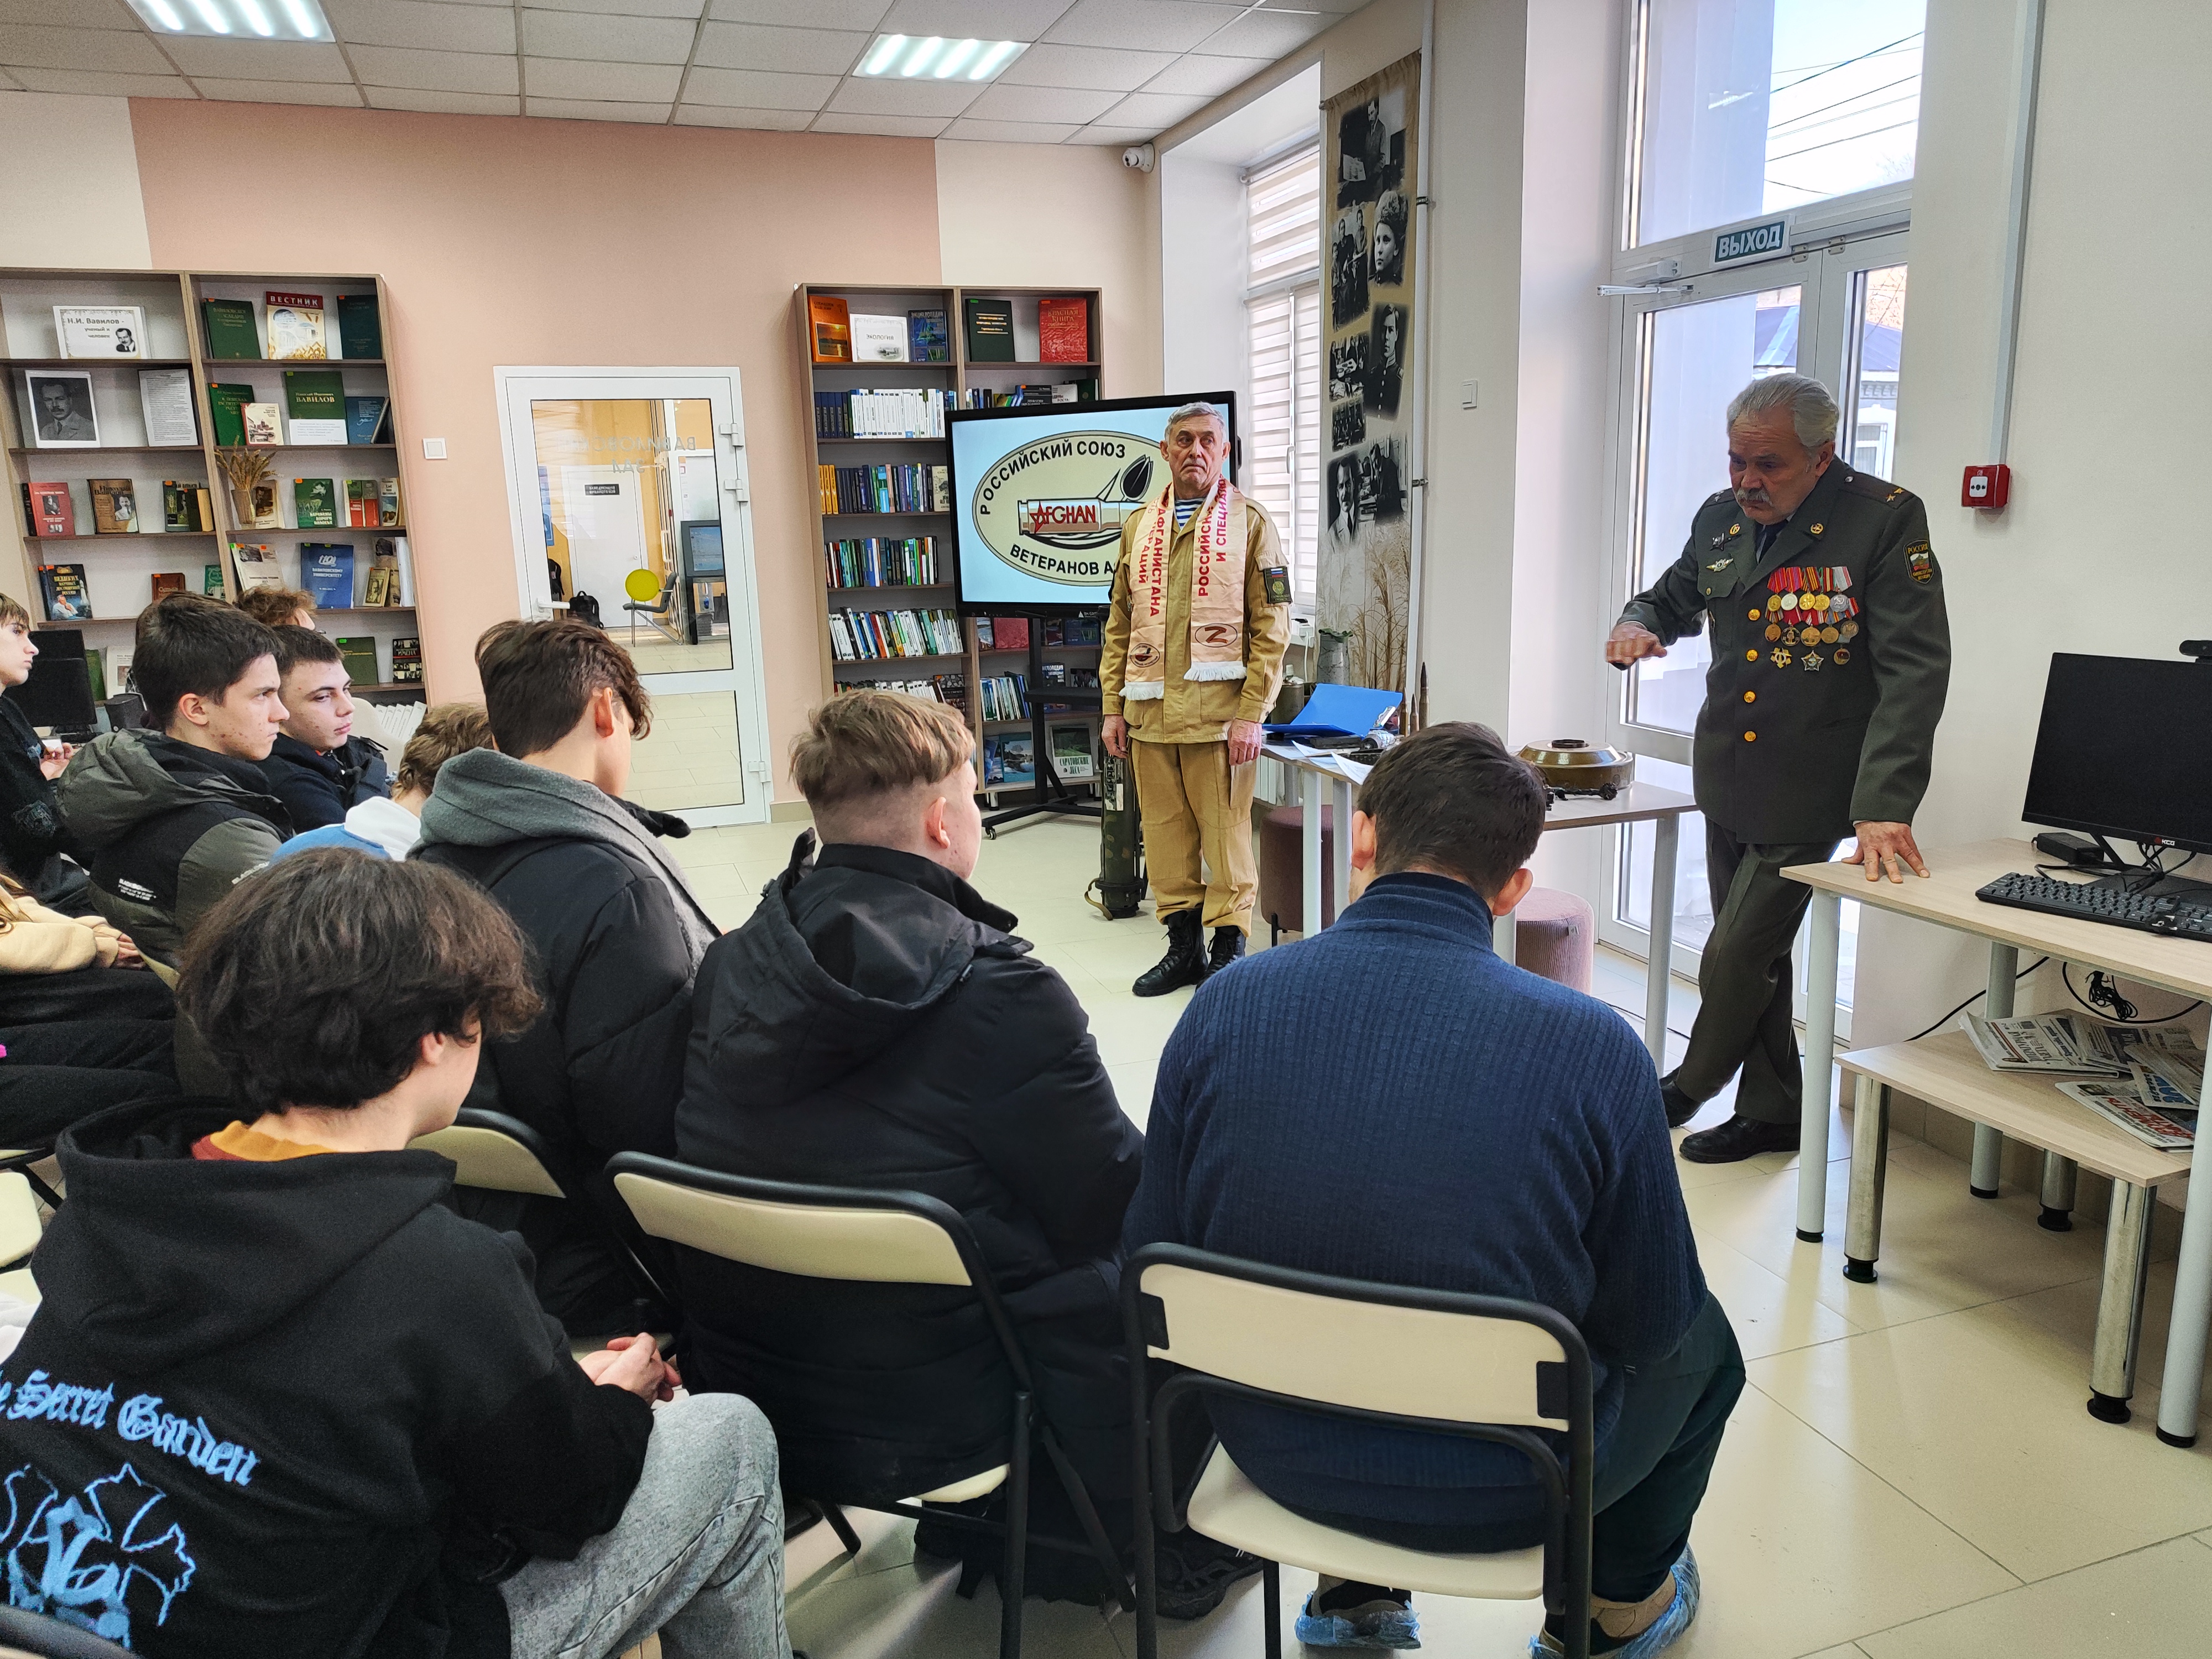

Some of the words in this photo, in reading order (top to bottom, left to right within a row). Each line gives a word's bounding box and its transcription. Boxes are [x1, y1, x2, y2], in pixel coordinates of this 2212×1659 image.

[1718, 225, 1781, 258] ВЫХОД
[270, 296, 318, 306] ВЕСТНИК
[980, 439, 1074, 515] РОССИЙСКИЙ
[1076, 440, 1126, 458] СОЮЗ
[1907, 542, 1929, 554] РОССИЯ
[1010, 544, 1099, 576] ВЕТЕРАНОВ
[1150, 508, 1166, 617] АФГАНИСТАНА
[1216, 552, 1227, 562] И
[1205, 627, 1228, 644] Z
[1060, 757, 1089, 766] САРАТОВСКИЕ
[1070, 766, 1081, 774] ЛЕСА
[118, 1394, 260, 1486] Garden
